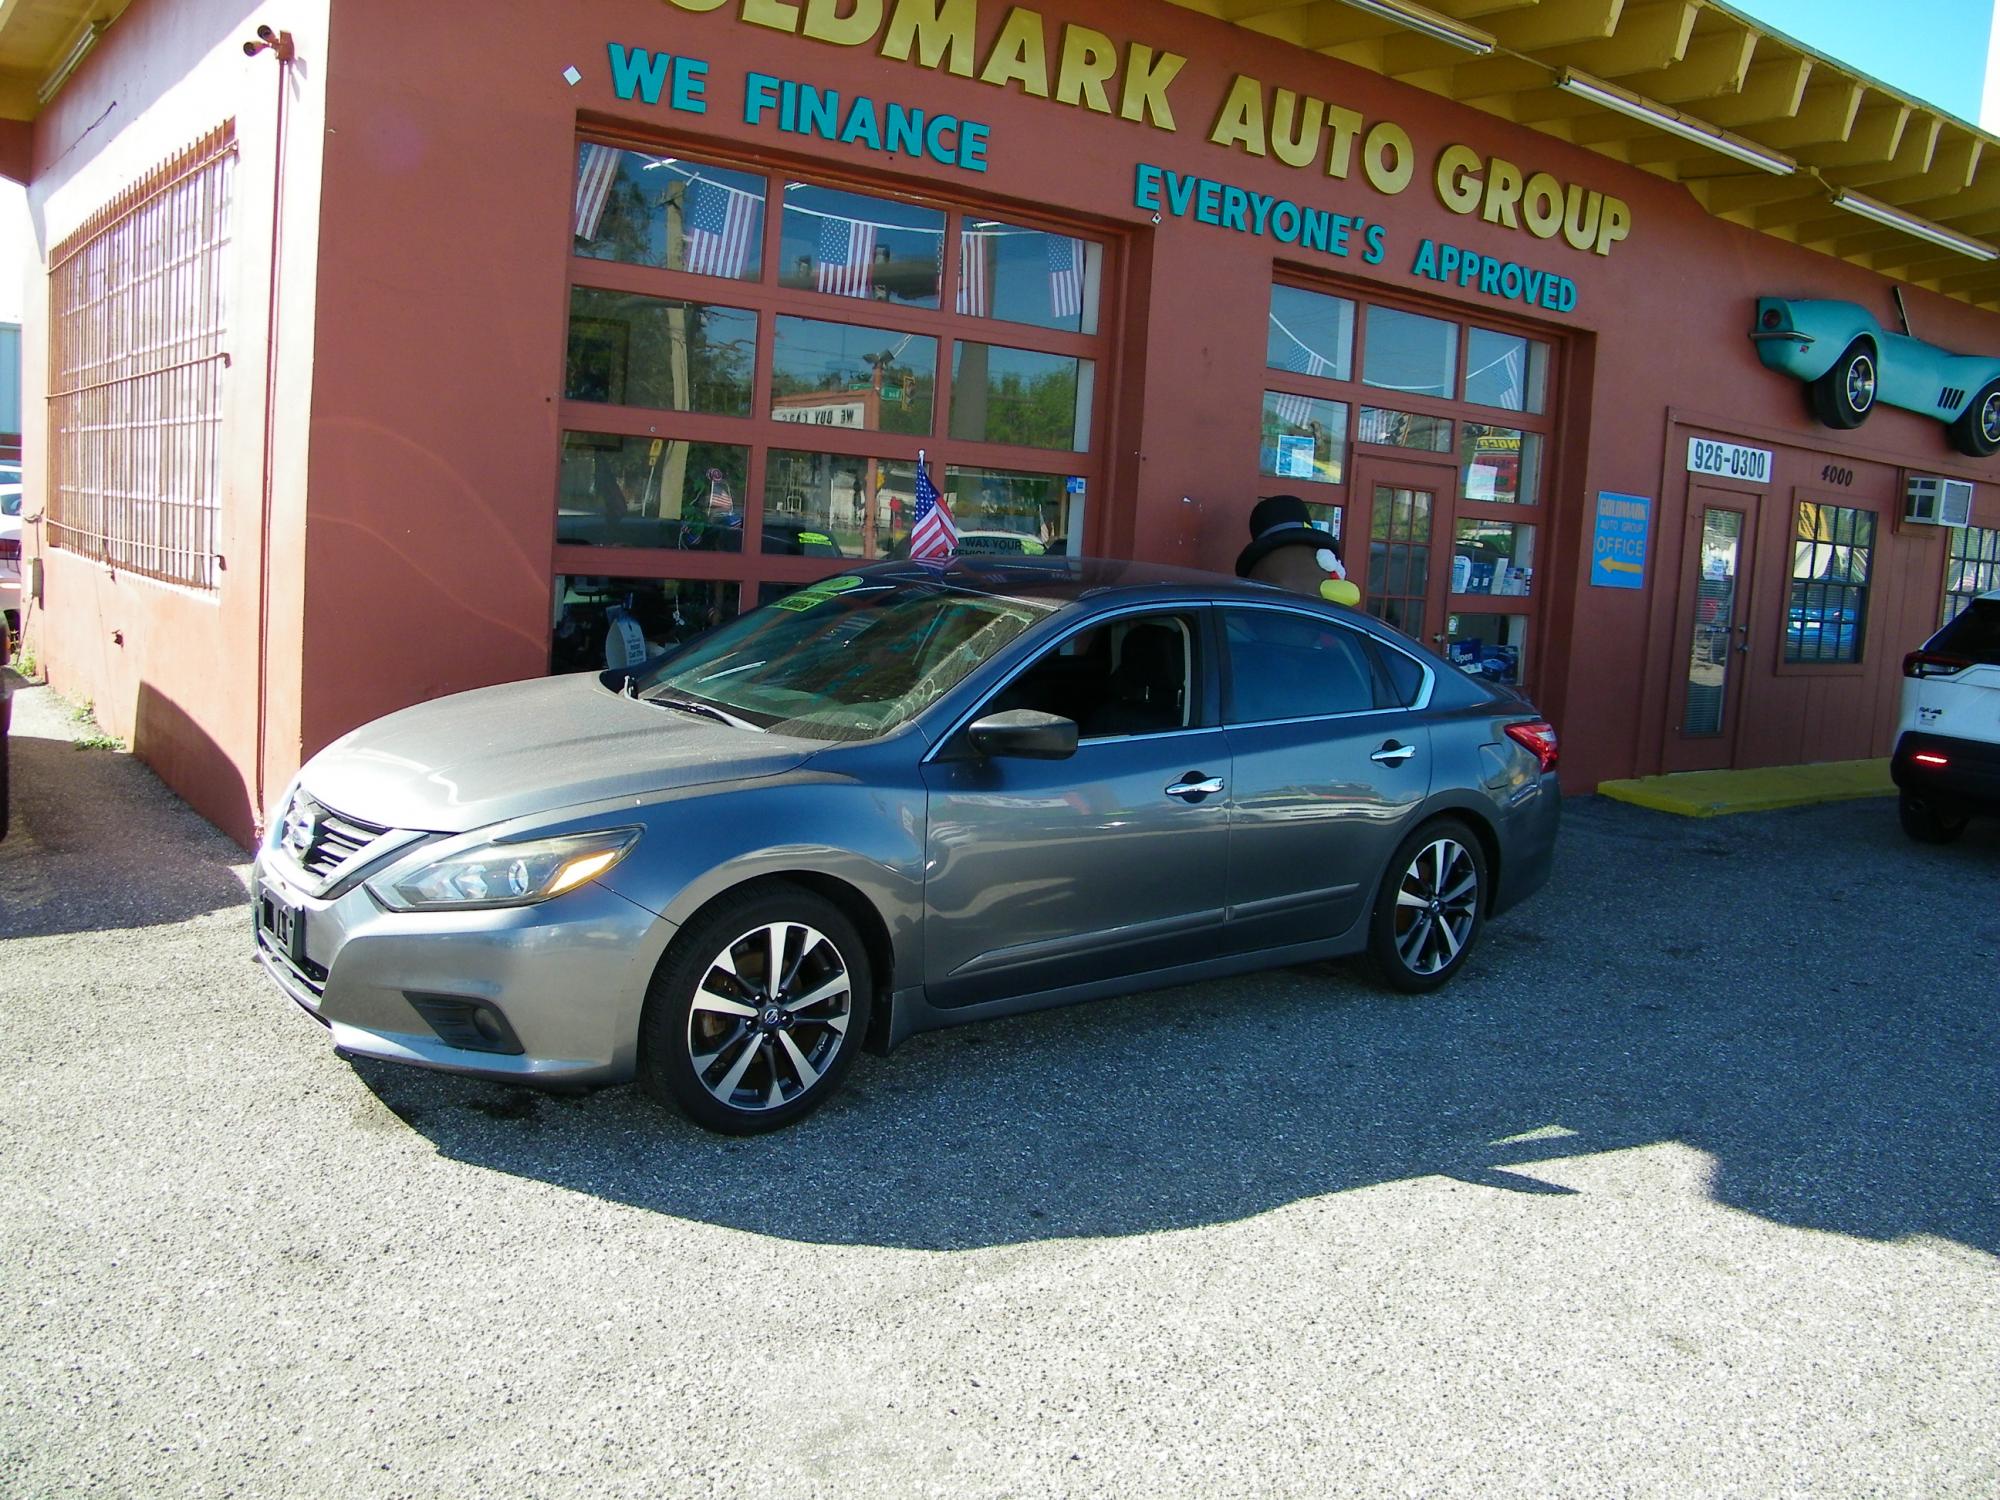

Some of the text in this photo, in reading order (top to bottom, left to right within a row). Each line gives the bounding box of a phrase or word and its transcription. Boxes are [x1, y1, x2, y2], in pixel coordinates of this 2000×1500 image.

[607, 42, 991, 173] WE FINANCE
[1209, 74, 1415, 196] AUTO
[1435, 144, 1632, 257] GROUP
[1135, 162, 1578, 314] EVERYONE'S APPROVED
[1694, 440, 1765, 479] 926-0300
[1821, 464, 1853, 487] 4000
[965, 538, 989, 548] WAX
[992, 539, 1022, 551] YOUR
[1597, 536, 1644, 557] OFFICE
